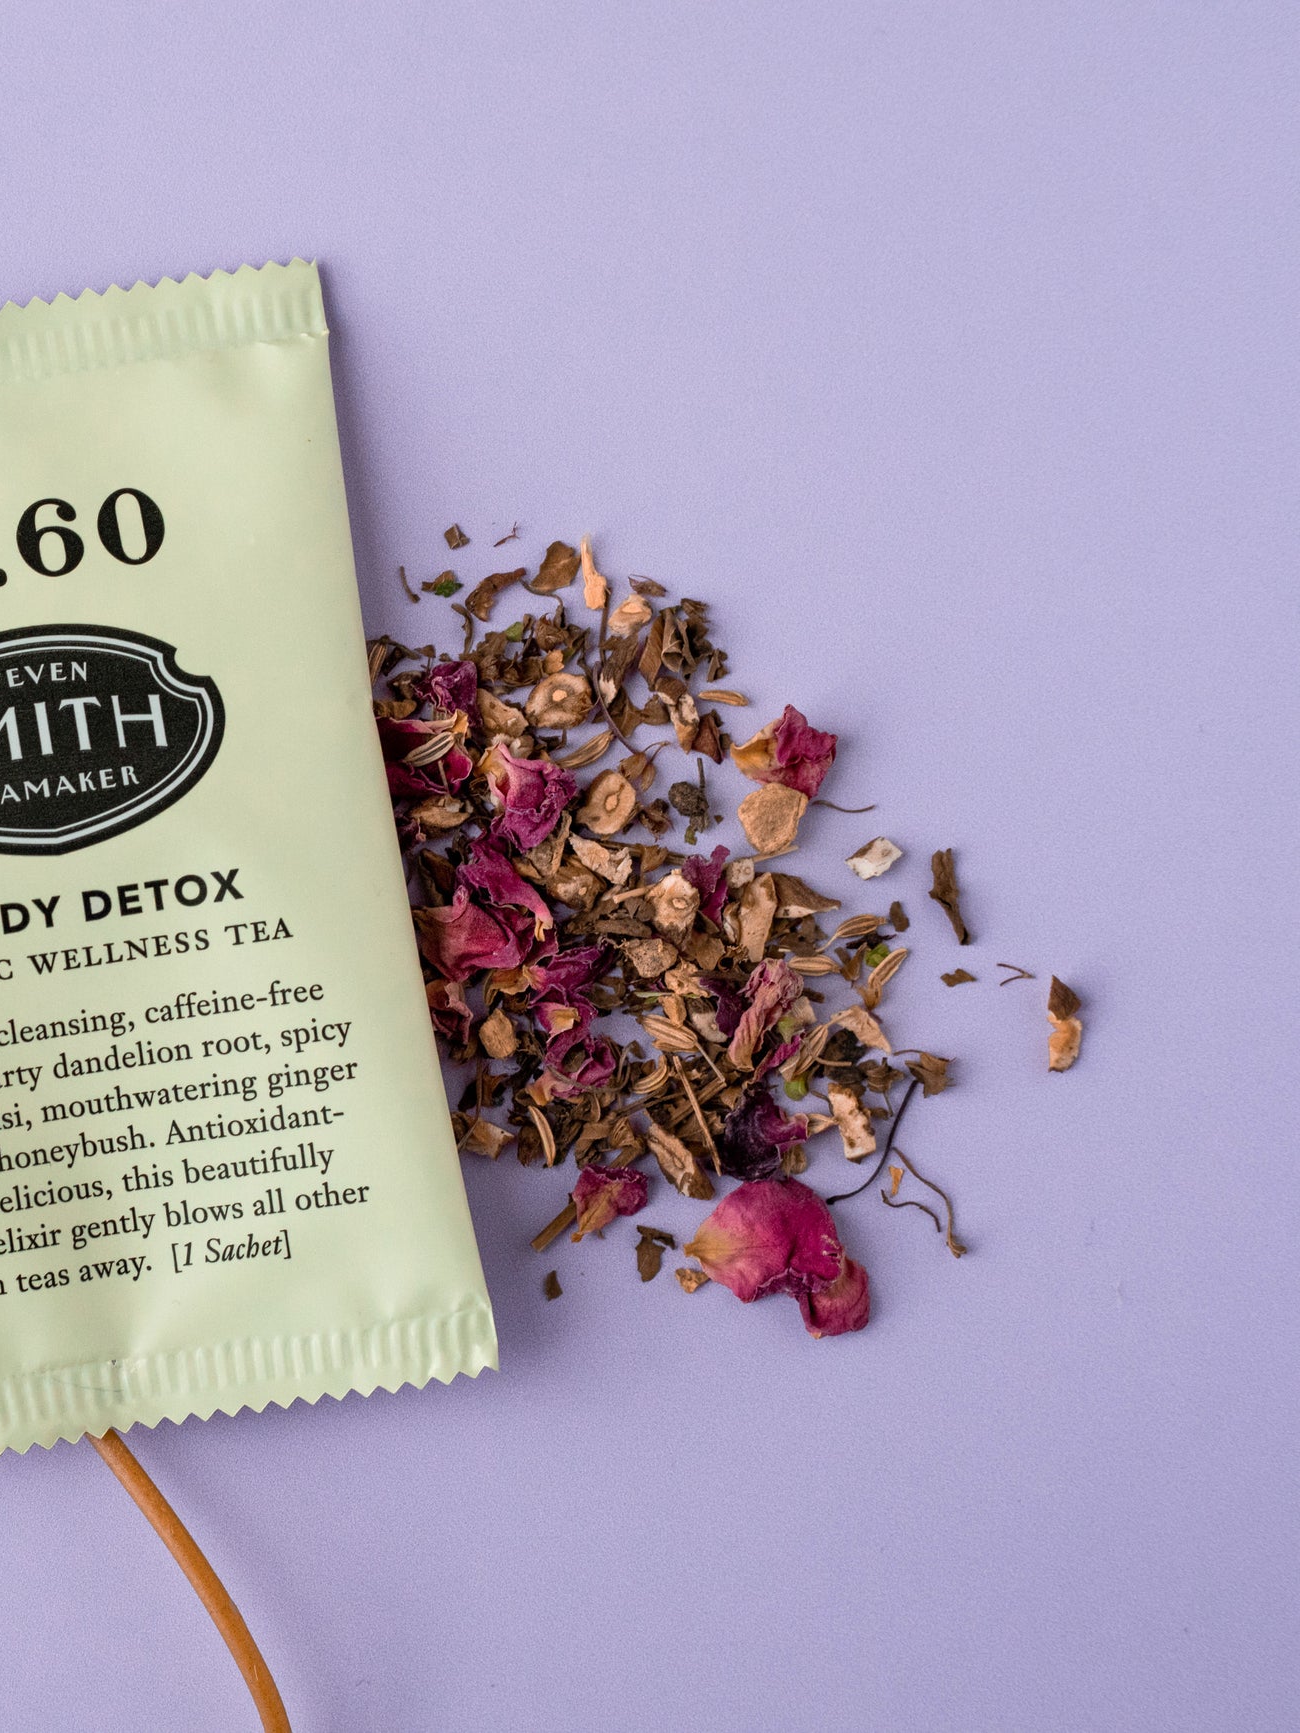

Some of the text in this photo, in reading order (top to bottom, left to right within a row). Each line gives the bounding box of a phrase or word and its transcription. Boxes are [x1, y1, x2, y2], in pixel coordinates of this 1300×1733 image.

[81, 868, 245, 923] DETOX
[26, 929, 210, 976] WELLNESS
[223, 917, 294, 946] TEA
[144, 979, 325, 1024] caffeine-free
[52, 1040, 194, 1080] dandelion
[201, 1031, 271, 1058] root,
[280, 1017, 352, 1054] spicy
[40, 1072, 258, 1124] mouthwatering
[267, 1062, 358, 1099] ginger
[165, 1104, 345, 1146] Antioxidant-
[121, 1163, 174, 1193] this
[181, 1141, 335, 1184] beautifully
[70, 1206, 156, 1251] gently
[162, 1199, 244, 1228] blows
[252, 1187, 287, 1217] all
[294, 1181, 370, 1211] other
[15, 1268, 71, 1293] teas
[78, 1255, 152, 1283] away.
[171, 1241, 193, 1274] [1
[204, 1229, 292, 1264] Sachet]
